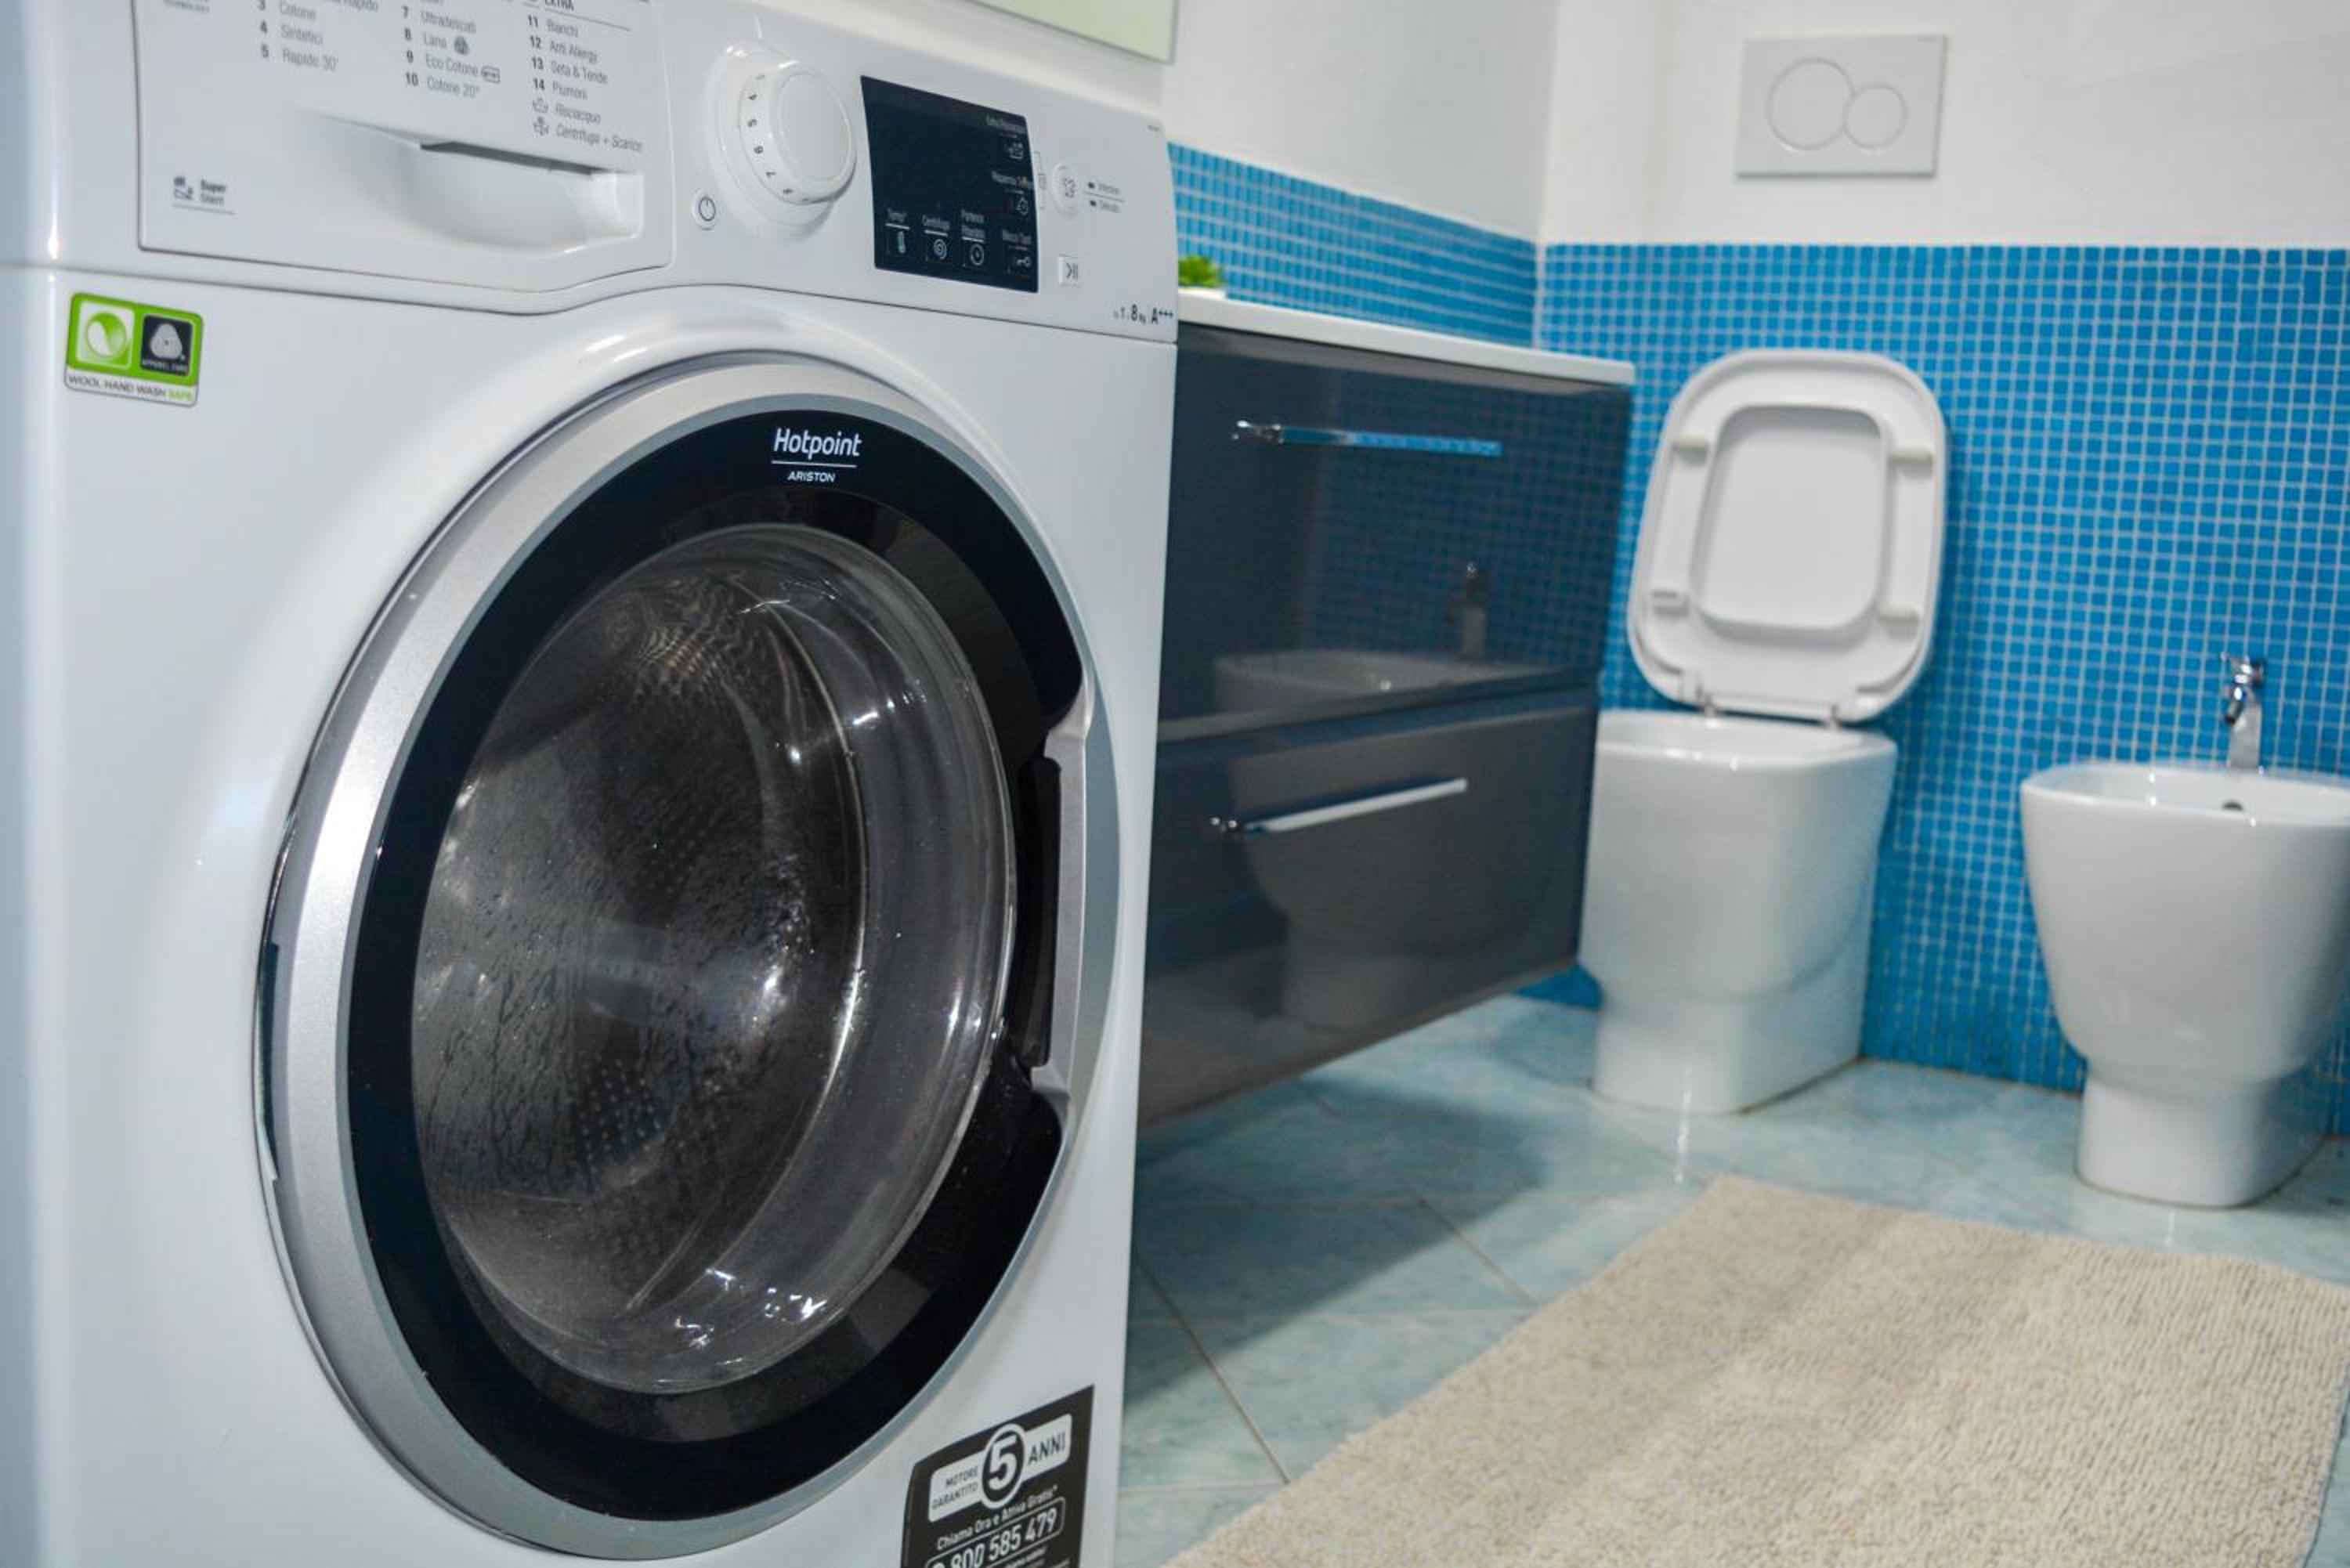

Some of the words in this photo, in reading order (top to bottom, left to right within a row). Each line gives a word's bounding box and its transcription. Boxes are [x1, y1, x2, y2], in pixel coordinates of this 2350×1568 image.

[402, 5, 410, 19] 7
[259, 20, 268, 34] 4
[528, 14, 539, 27] 11
[530, 35, 542, 49] 12
[260, 43, 270, 59] 5
[407, 49, 414, 63] 9
[531, 56, 544, 70] 13
[405, 71, 419, 87] 10
[533, 78, 545, 92] 14
[67, 374, 100, 388] WOOL
[104, 380, 136, 392] HAND
[137, 385, 166, 397] WASH
[773, 427, 862, 461] Hotpoint
[786, 471, 836, 483] ARISTON
[988, 1433, 1018, 1491] 5
[1027, 1430, 1066, 1465] ANNI
[945, 1465, 979, 1489] MOTORE
[937, 1526, 974, 1551] Chiama
[974, 1518, 992, 1534] Ora
[950, 1542, 985, 1568] 800
[988, 1523, 1023, 1563] 585
[1025, 1507, 1058, 1542] 479
